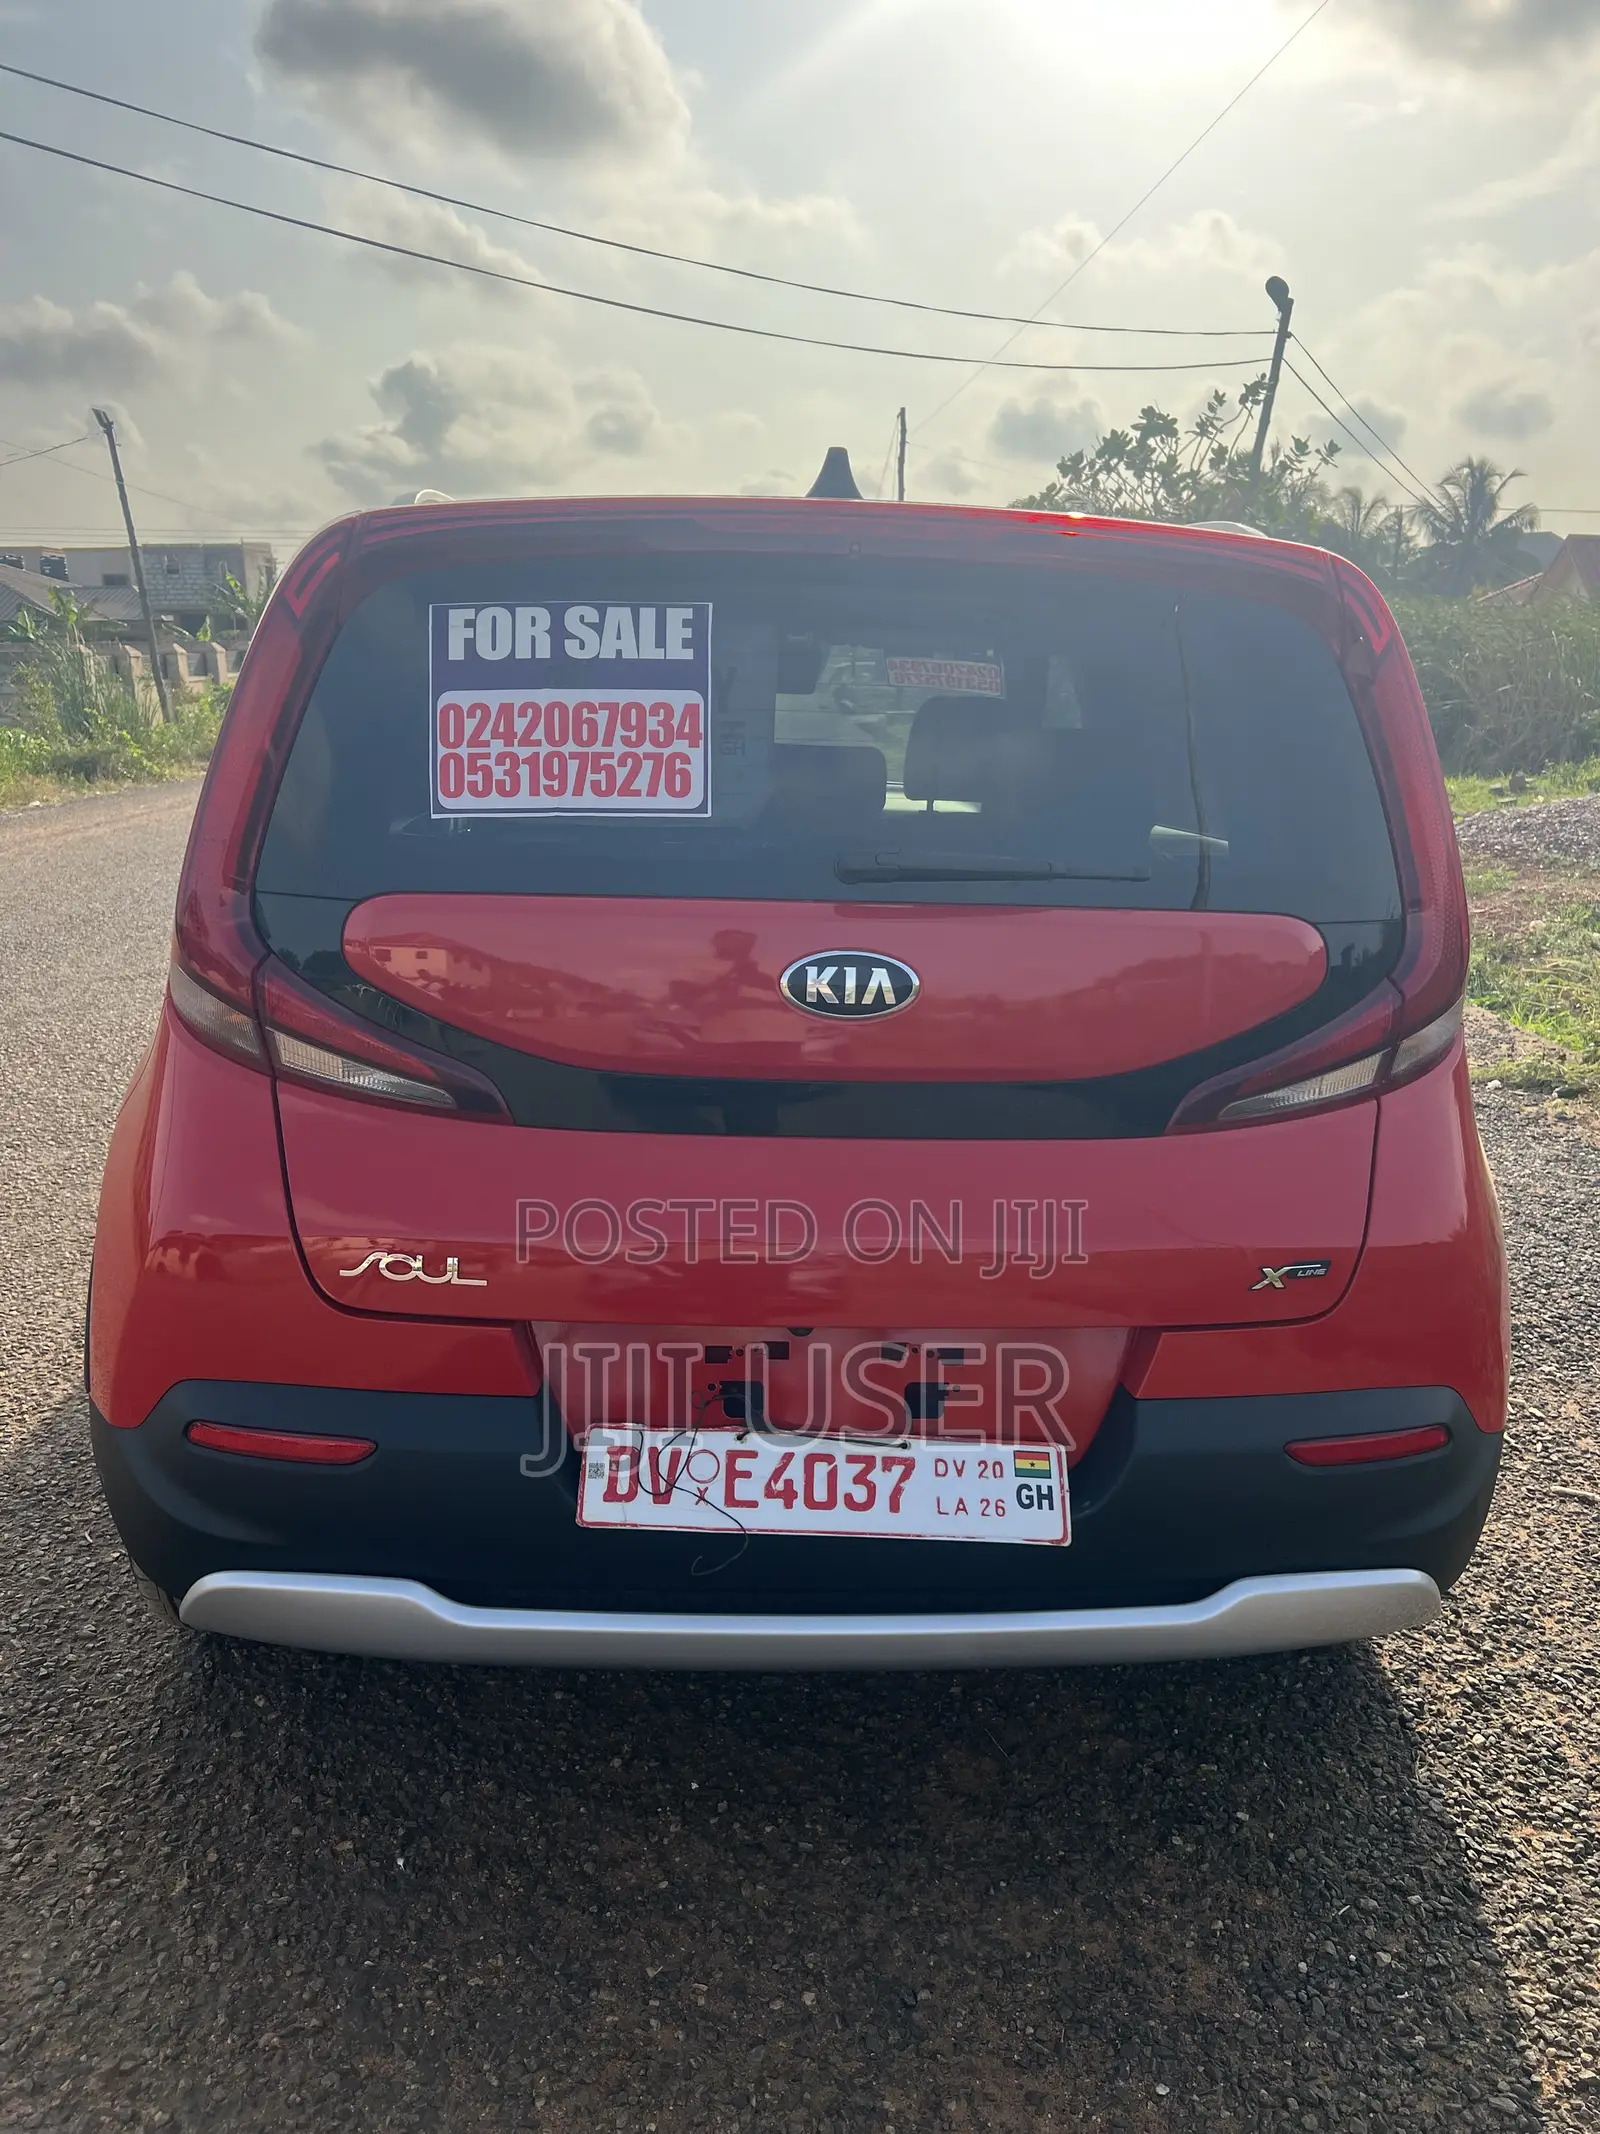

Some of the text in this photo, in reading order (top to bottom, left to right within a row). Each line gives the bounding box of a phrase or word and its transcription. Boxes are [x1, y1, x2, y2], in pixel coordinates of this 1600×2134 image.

[448, 605, 694, 660] FOR SALE
[439, 701, 703, 750] 0242067934
[439, 751, 692, 799] 0531975276
[805, 966, 897, 1005] KIA
[339, 1251, 488, 1287] SOUL
[1296, 1268, 1328, 1277] LINE
[603, 1445, 684, 1505] DV
[724, 1449, 916, 1514] E4037
[934, 1458, 1004, 1479] DV 20
[936, 1496, 1005, 1517] LA 26
[1015, 1483, 1055, 1511] GH
